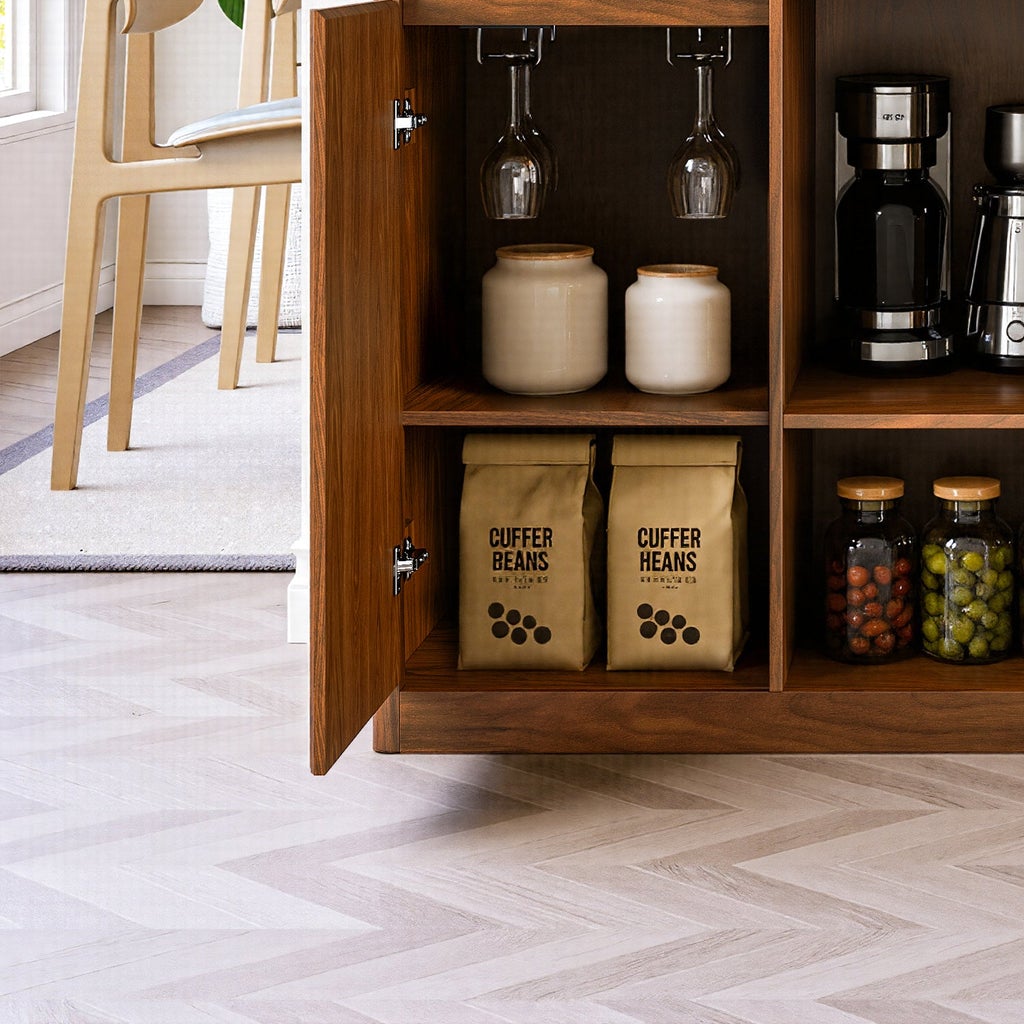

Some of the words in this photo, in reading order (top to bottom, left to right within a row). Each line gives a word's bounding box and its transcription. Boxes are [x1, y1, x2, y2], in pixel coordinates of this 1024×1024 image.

[489, 527, 553, 548] CUFFER
[637, 527, 701, 548] CUFFER
[492, 550, 549, 571] BEANS
[640, 551, 697, 572] HEANS
